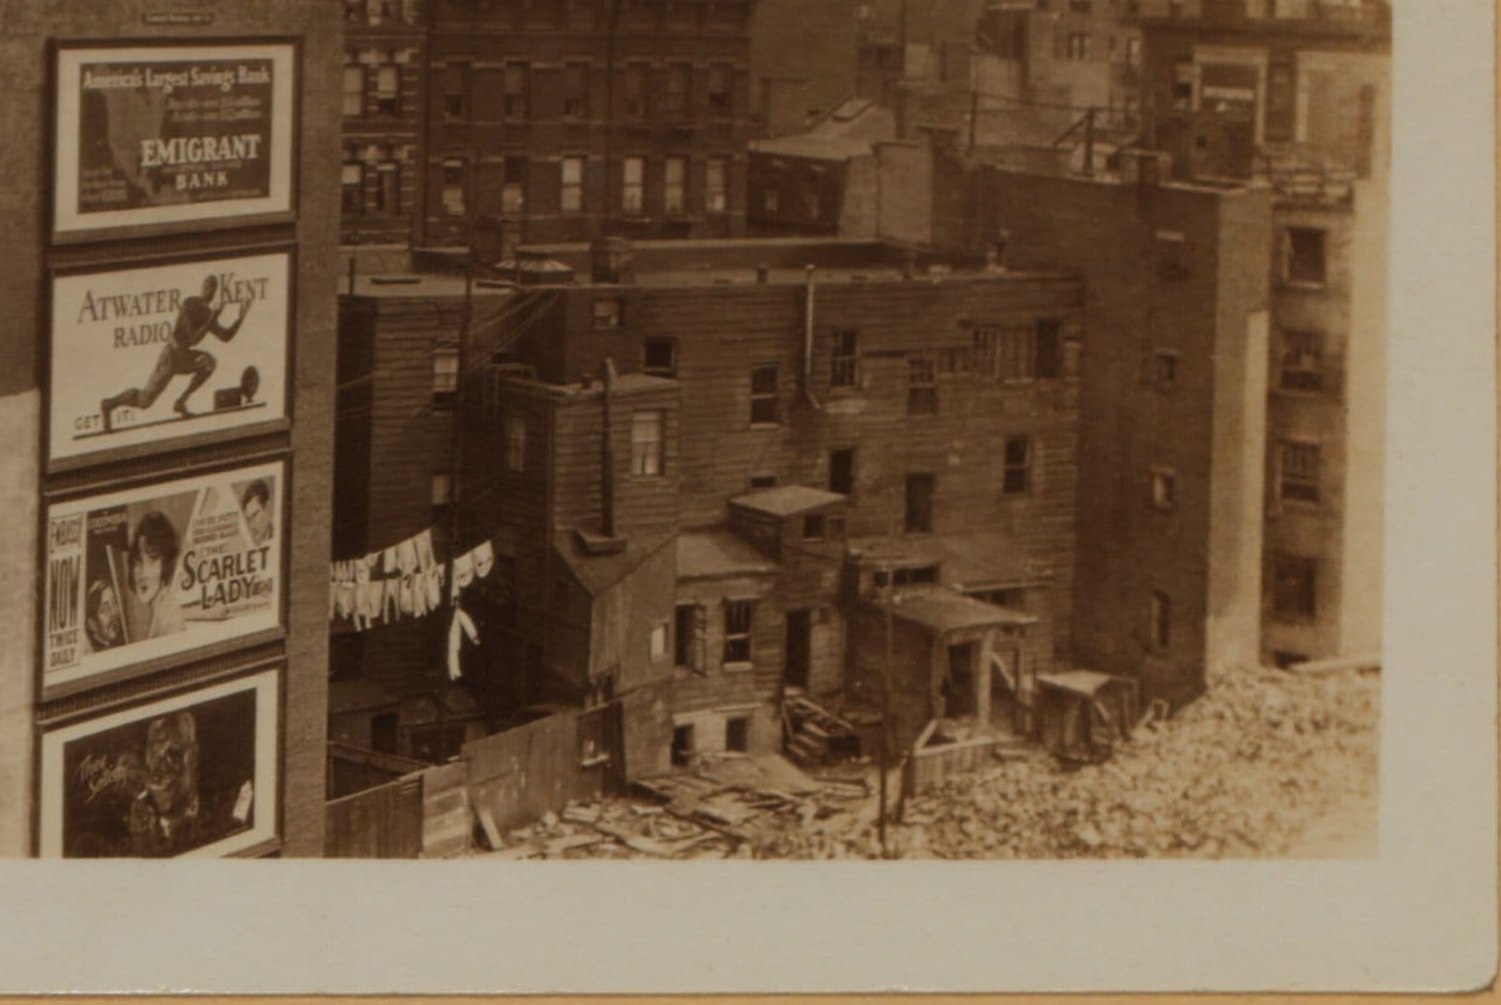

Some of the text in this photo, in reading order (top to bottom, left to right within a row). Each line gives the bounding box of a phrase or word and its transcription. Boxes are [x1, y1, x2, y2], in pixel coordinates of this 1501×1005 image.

[145, 67, 189, 94] Largest
[190, 65, 235, 92] Savings
[238, 64, 270, 85] Bank
[141, 134, 261, 167] EMIGRANT
[175, 171, 229, 191] BANK
[77, 272, 269, 324] ATWATER KENT
[113, 321, 173, 349] RADIO
[74, 414, 100, 431] GET
[181, 546, 271, 591] SCARLET
[202, 577, 256, 611] LADY
